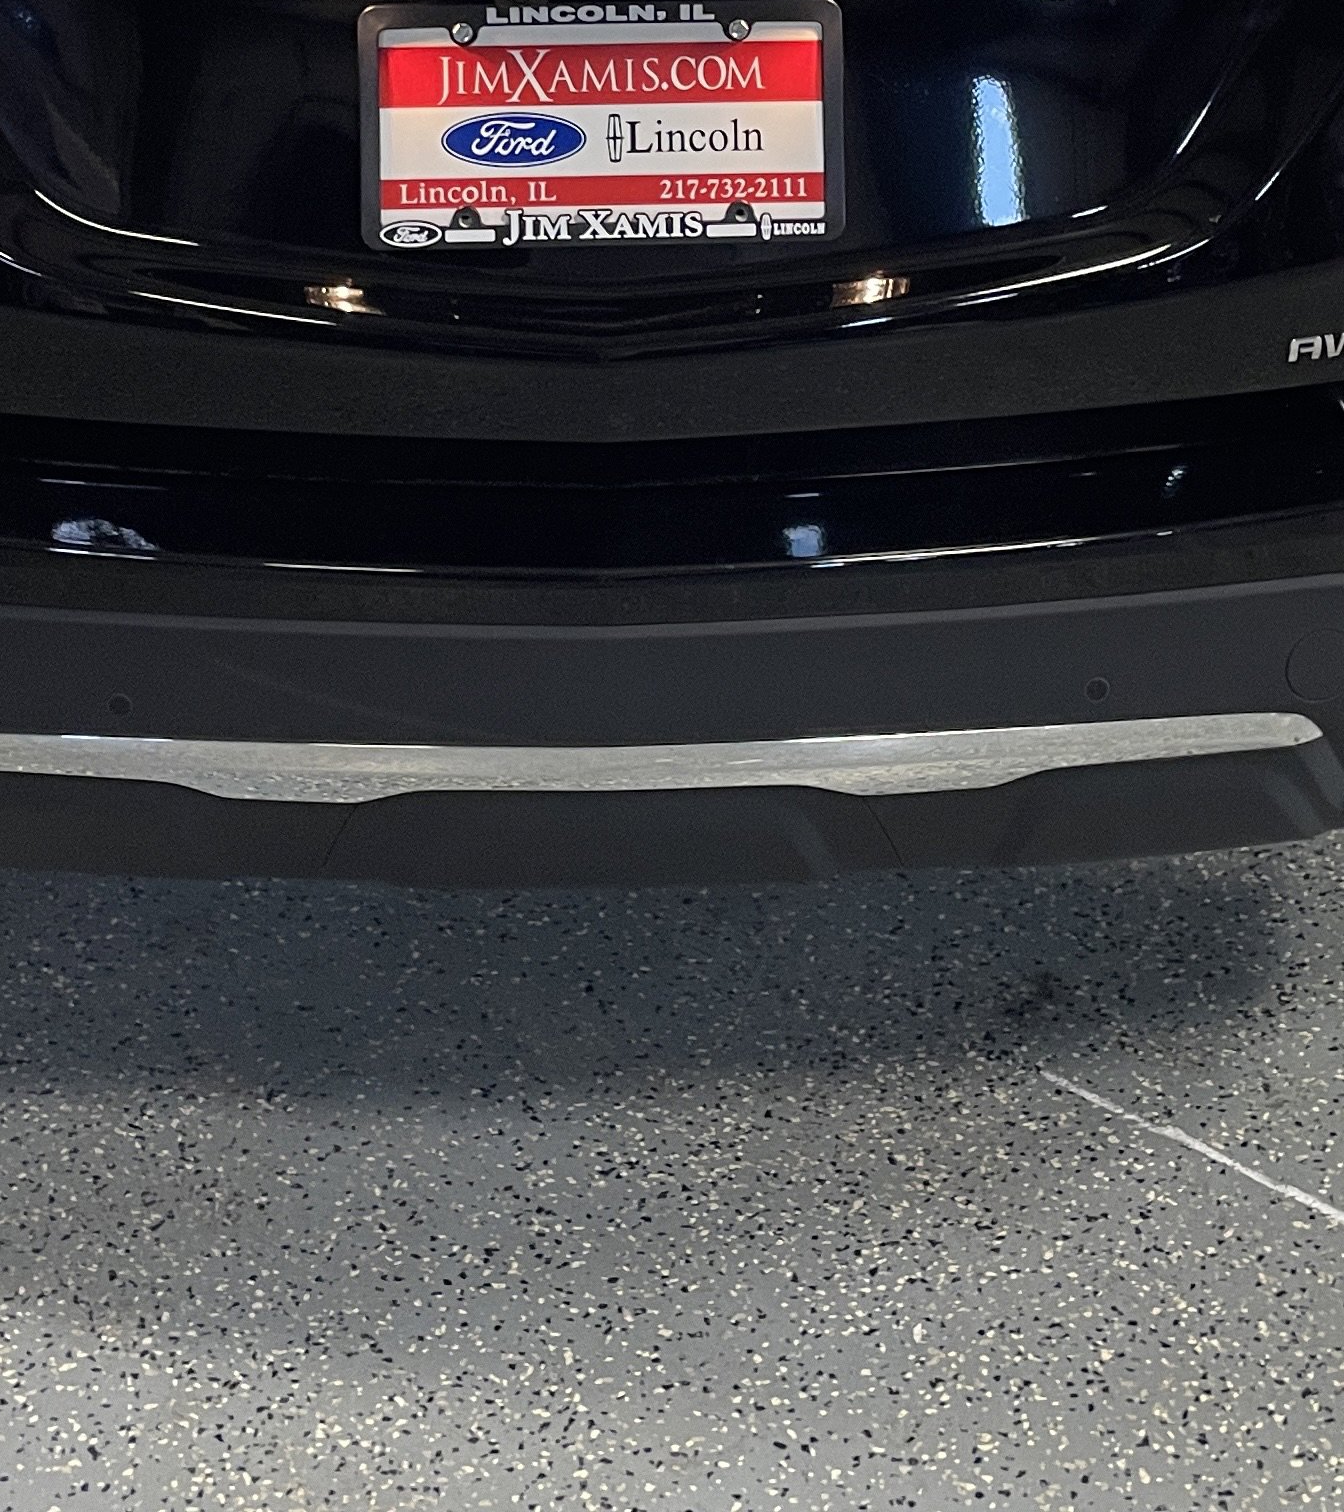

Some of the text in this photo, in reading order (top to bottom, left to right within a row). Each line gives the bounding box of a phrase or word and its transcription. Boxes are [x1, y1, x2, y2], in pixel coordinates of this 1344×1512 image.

[485, 3, 715, 25] LINCOLN, IL
[470, 119, 558, 159] Ford
[626, 118, 764, 155] Lincoln
[399, 181, 557, 207] Lincoln, IL
[659, 176, 808, 201] 217-732-2111
[392, 225, 430, 245] Ford
[502, 207, 704, 247] JIM XAMIS
[772, 221, 827, 238] LINCOLN
